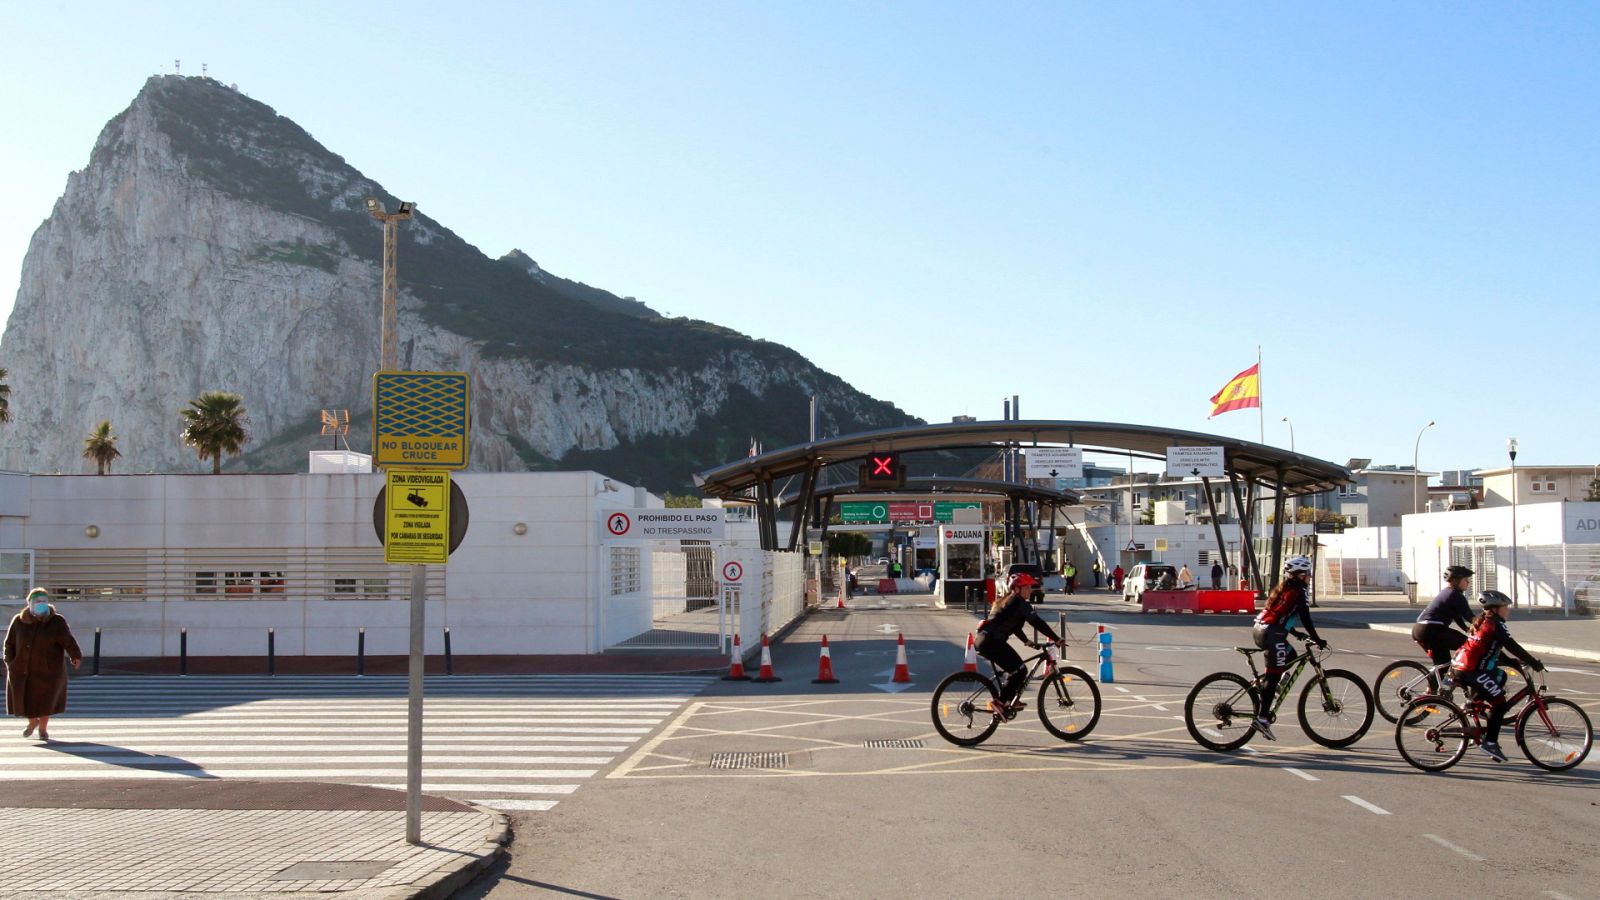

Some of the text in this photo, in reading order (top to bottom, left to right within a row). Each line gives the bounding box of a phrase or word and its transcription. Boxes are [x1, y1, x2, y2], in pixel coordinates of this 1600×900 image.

[382, 441, 457, 450] NO BLOQUEAR
[402, 451, 437, 459] CRUCE
[392, 474, 444, 484] ZONA VIDEOVIGILADA
[638, 514, 718, 522] PROHIBIDO EL PASO
[643, 527, 712, 535] NO TRESPASSING
[953, 530, 982, 539] ADUANA
[422, 532, 443, 540] SEGURIDAD
[1275, 642, 1286, 667] UCM
[1476, 673, 1502, 697] UCM
